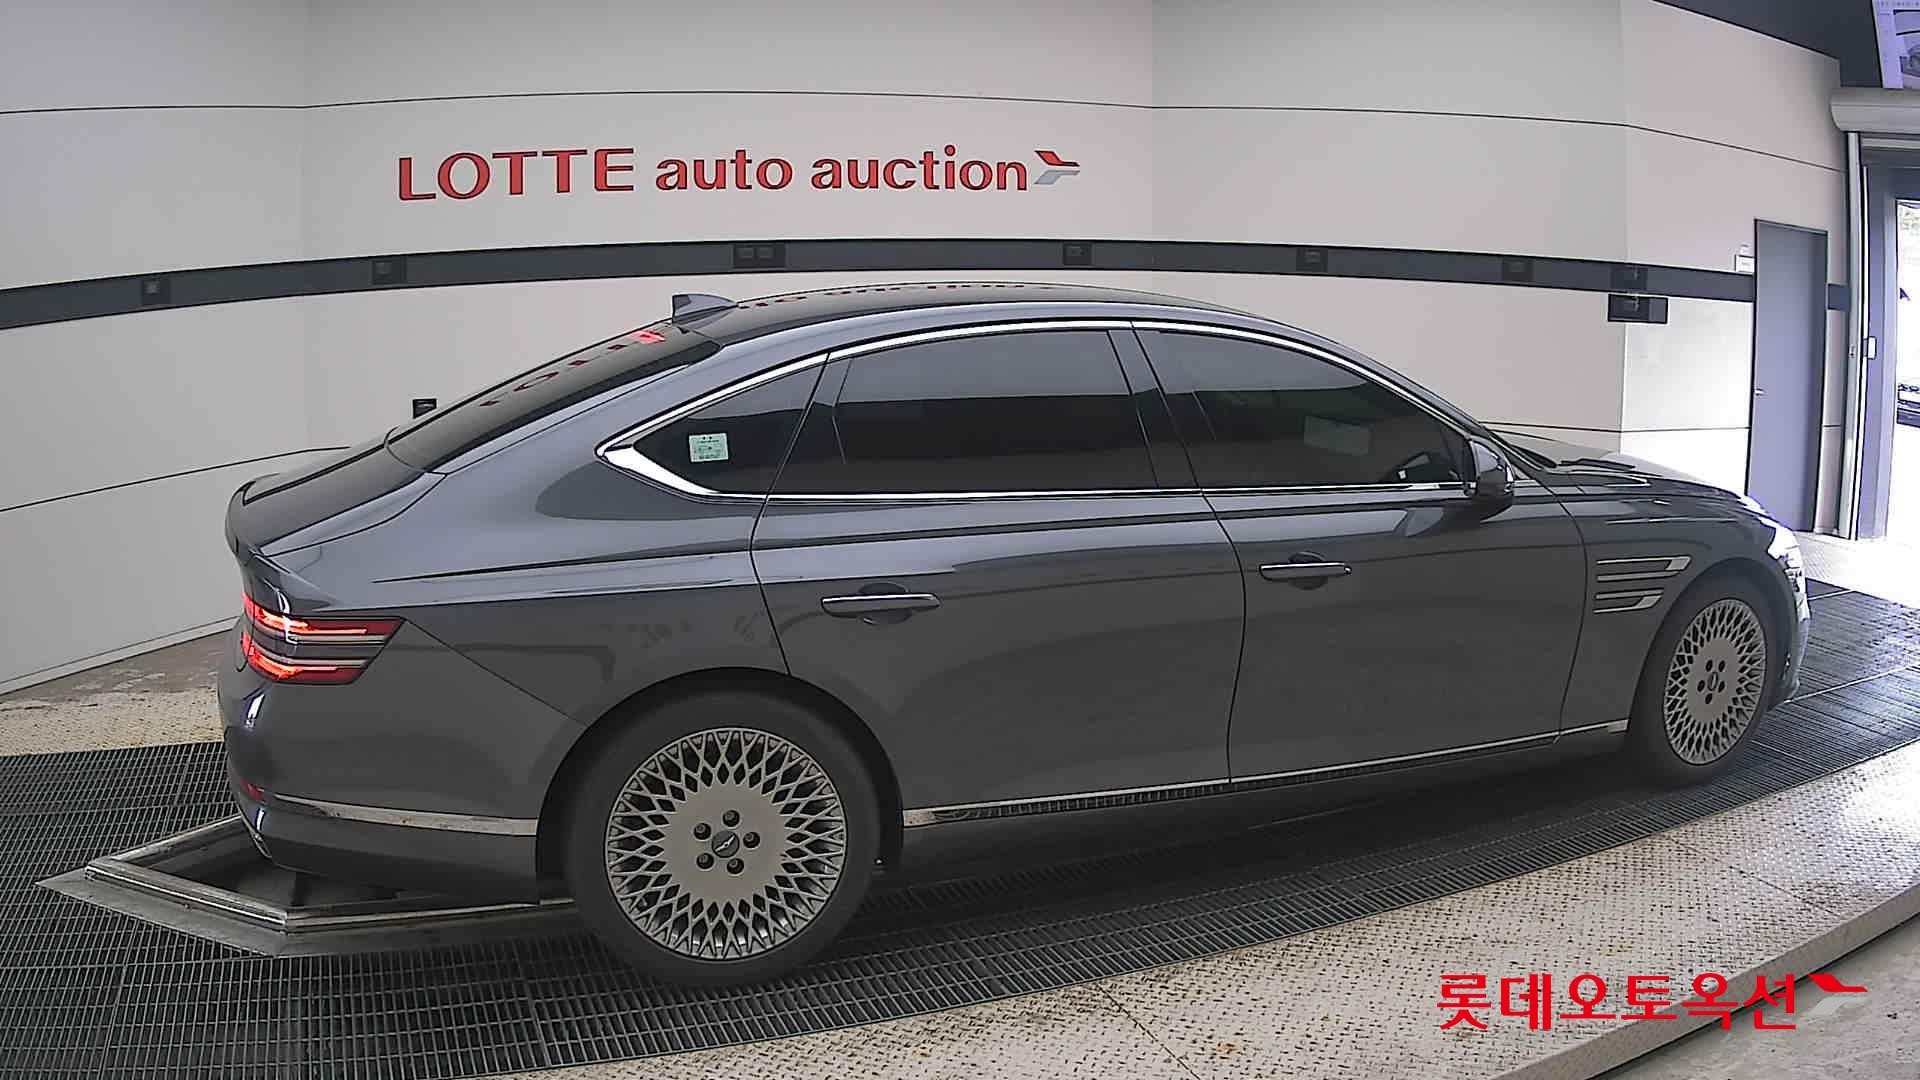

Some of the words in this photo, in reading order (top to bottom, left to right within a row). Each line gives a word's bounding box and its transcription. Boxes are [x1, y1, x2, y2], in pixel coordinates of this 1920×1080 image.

[399, 148, 635, 200] LOTTE
[656, 150, 793, 190] auto
[811, 146, 1027, 191] auction
